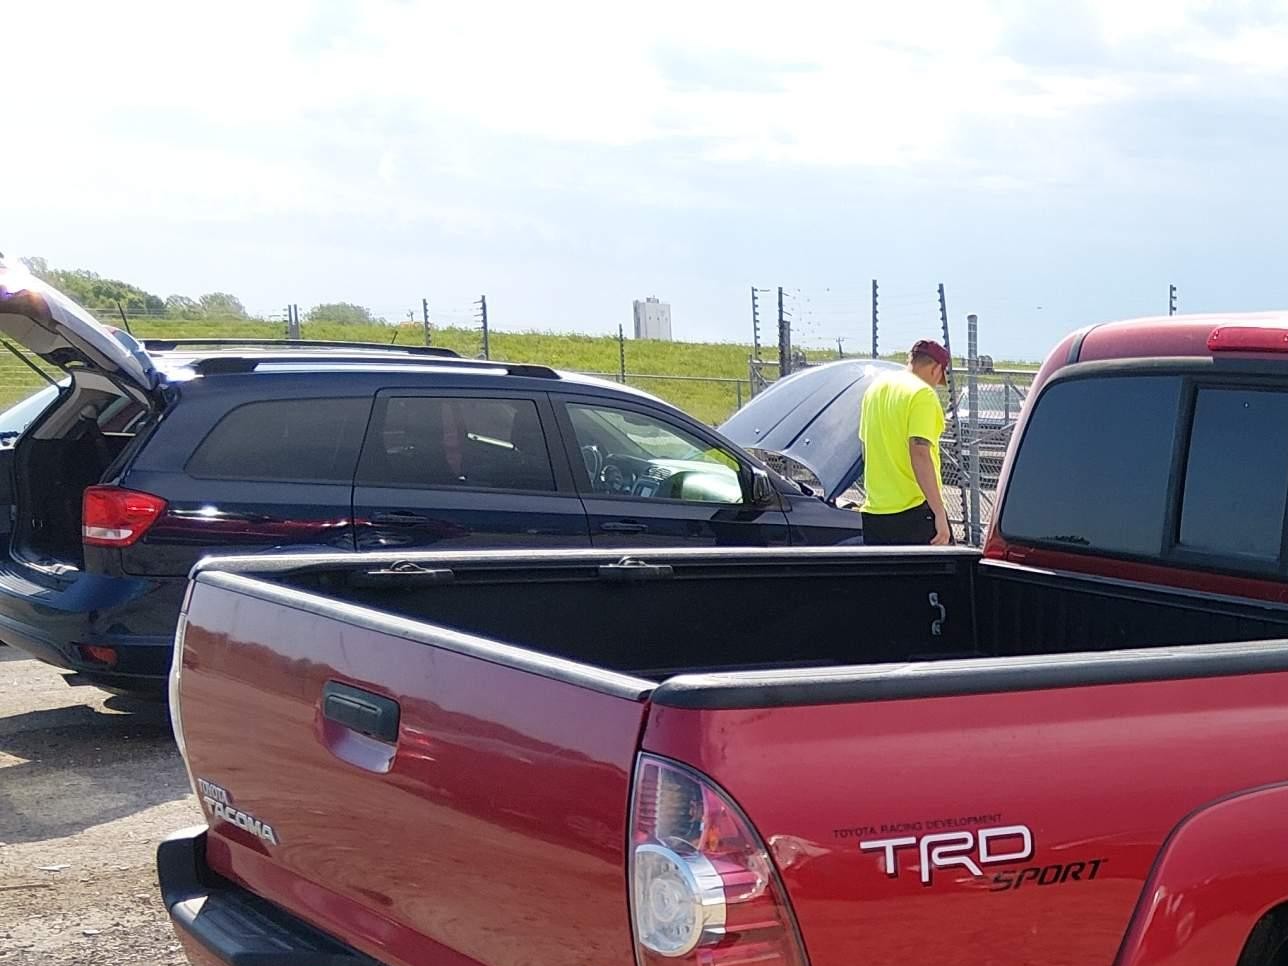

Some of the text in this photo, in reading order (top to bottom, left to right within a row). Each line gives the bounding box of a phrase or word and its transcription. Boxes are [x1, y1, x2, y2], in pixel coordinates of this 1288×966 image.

[198, 777, 231, 805] TOYOTA
[203, 795, 277, 845] TACOMA
[833, 814, 1003, 839] TOYOTA RACING DEVELOPMENT
[858, 824, 1035, 886] TRD
[989, 858, 1110, 892] SPORT
